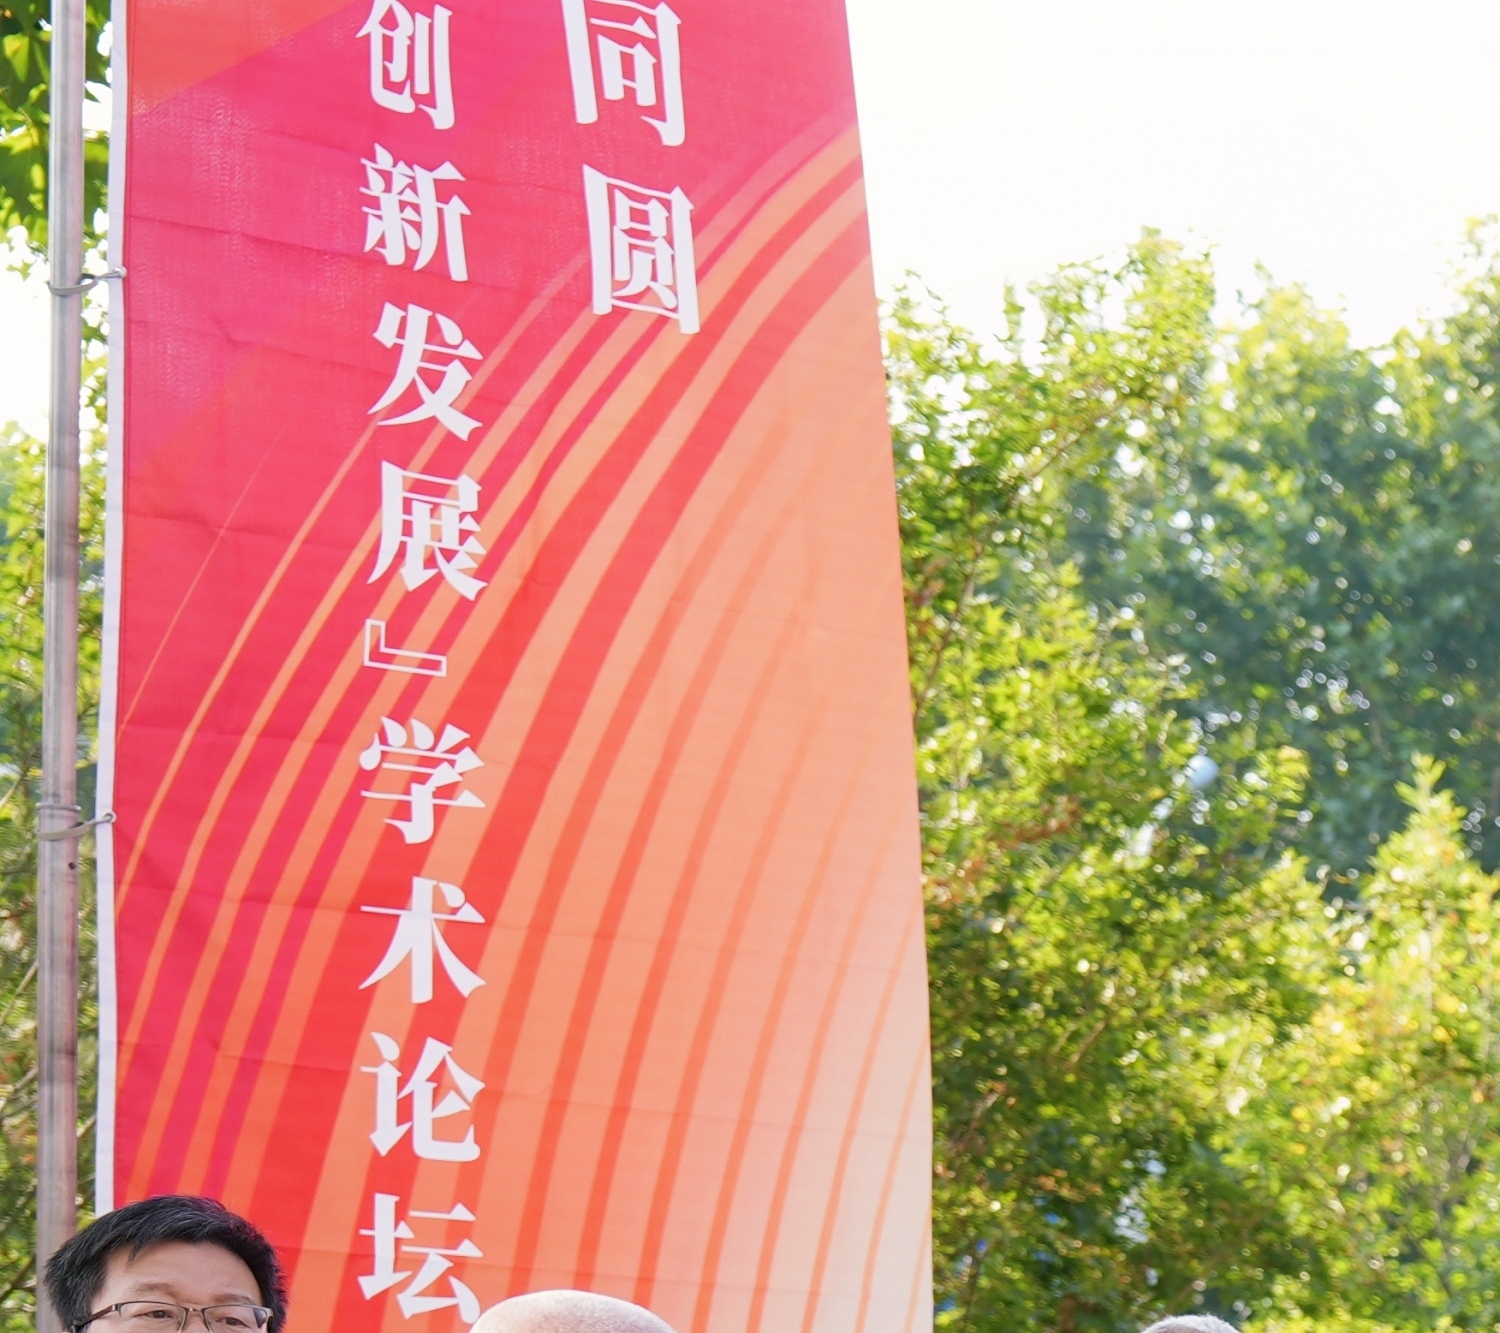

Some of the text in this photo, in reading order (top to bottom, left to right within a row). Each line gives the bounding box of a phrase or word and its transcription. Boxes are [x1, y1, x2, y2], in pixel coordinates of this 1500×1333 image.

[561, 0, 701, 335] 同圆
[354, 0, 488, 1323] 创新发展』学术论坛
